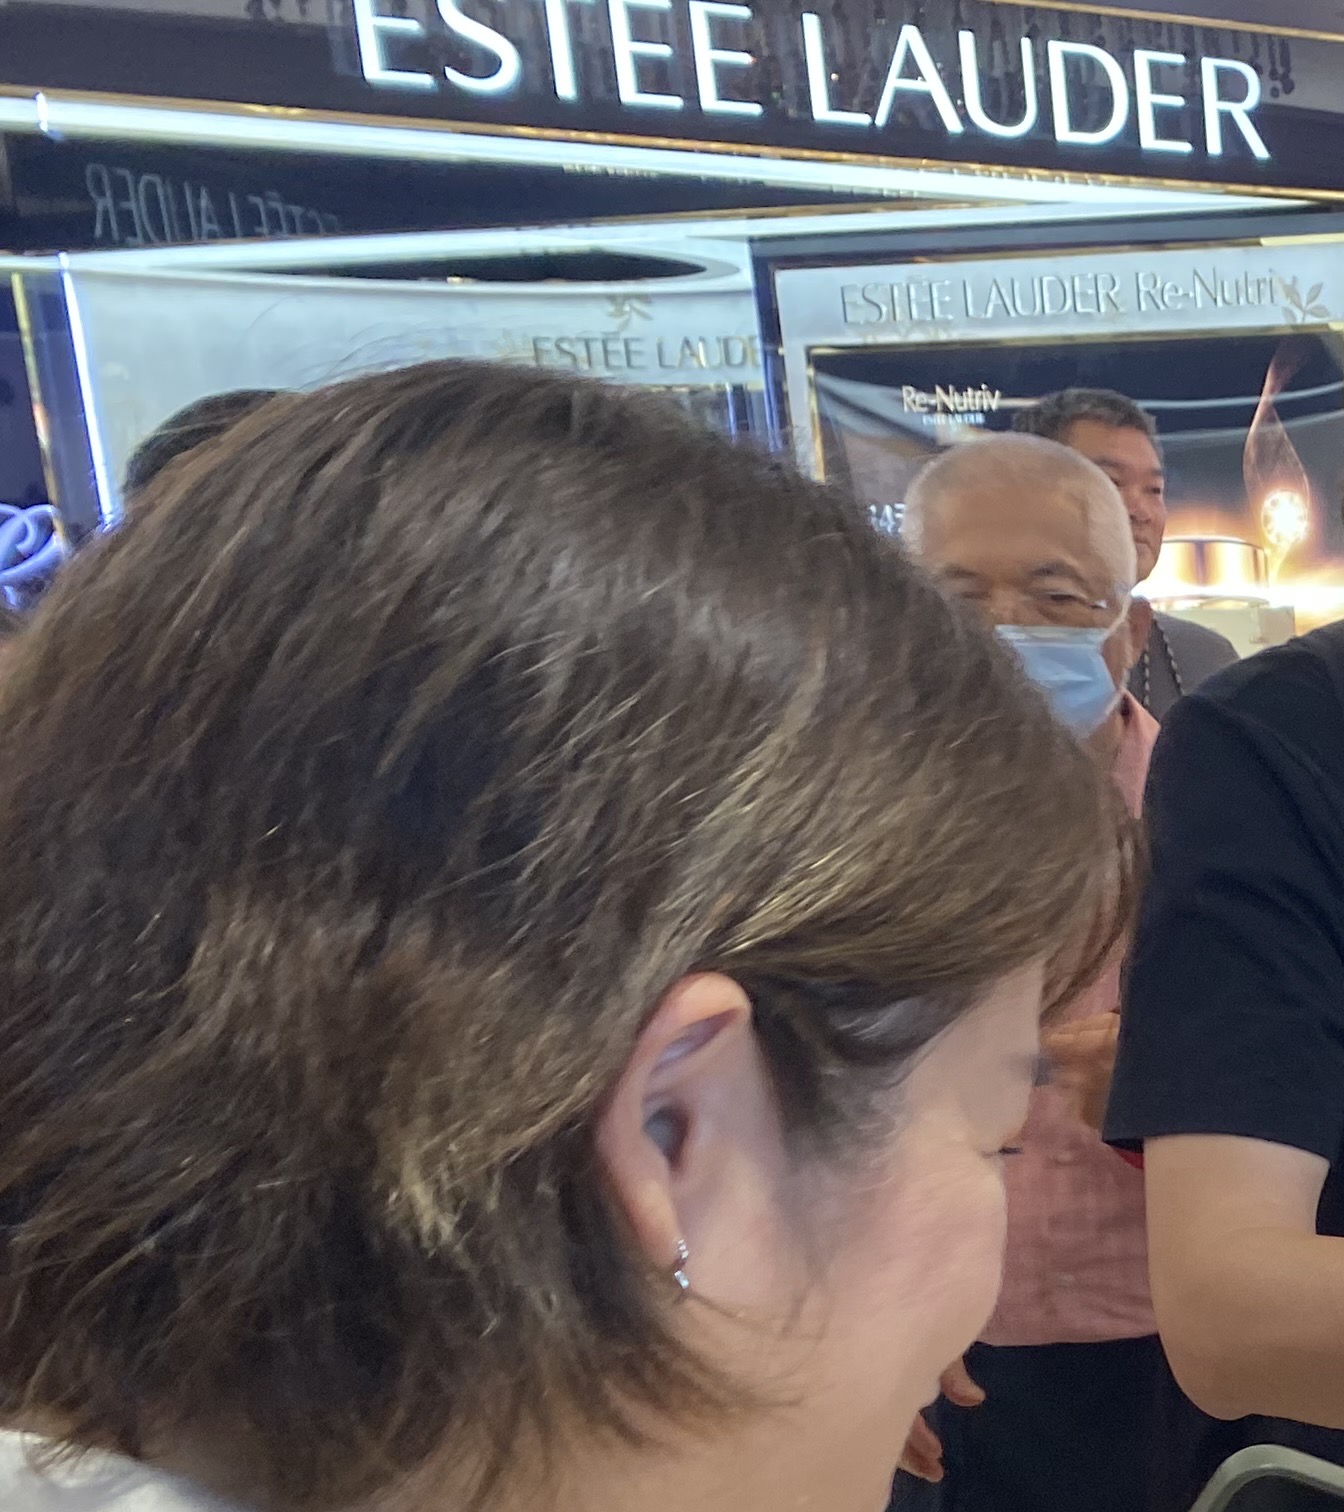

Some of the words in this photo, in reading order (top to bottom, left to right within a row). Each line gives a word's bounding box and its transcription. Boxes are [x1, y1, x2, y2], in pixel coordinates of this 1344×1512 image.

[802, 12, 1272, 160] LAUDER
[963, 270, 1120, 319] LAUDER
[902, 383, 1001, 413] Re-Nutriv
